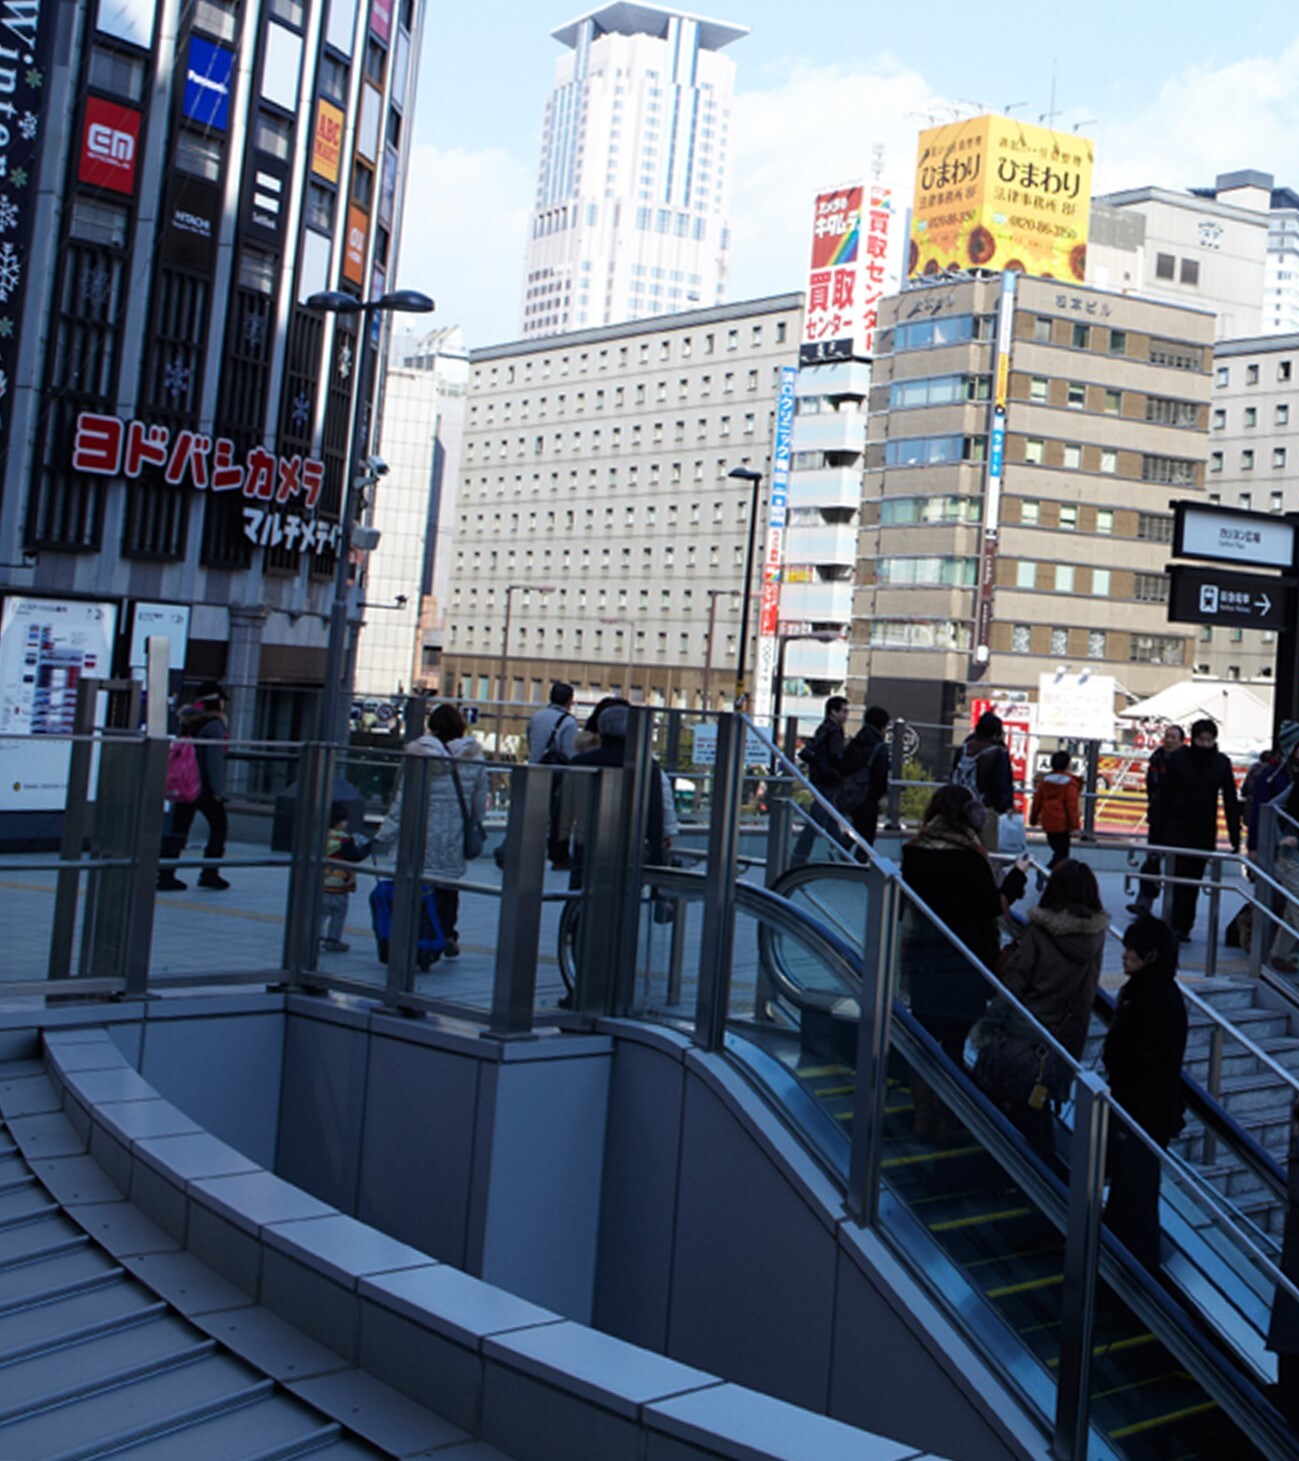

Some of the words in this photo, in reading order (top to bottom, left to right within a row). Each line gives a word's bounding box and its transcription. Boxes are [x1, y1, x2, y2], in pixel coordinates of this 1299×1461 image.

[0, 0, 40, 177] Wint
[921, 153, 981, 191] ひまわり
[997, 156, 1081, 199] ひまわり
[814, 210, 861, 239] キタムラ
[808, 267, 857, 315] 買取
[863, 210, 890, 351] 買取センター
[805, 312, 853, 341] センター
[72, 411, 326, 508] ヨドバシカメラ
[242, 506, 343, 559] マルチメディ
